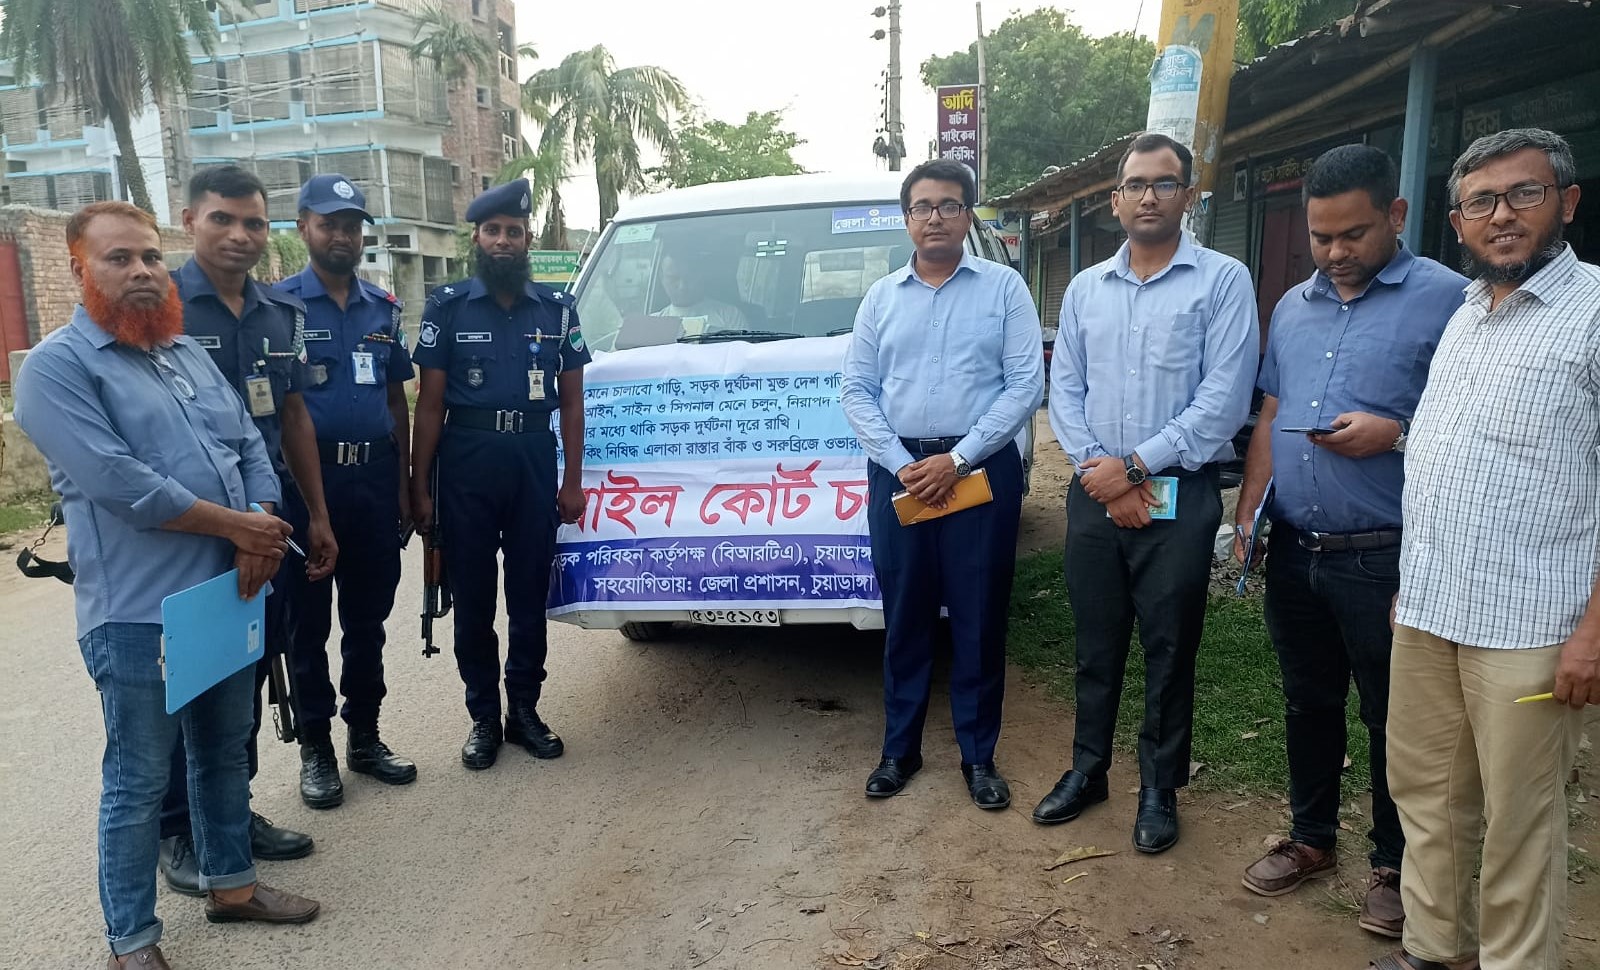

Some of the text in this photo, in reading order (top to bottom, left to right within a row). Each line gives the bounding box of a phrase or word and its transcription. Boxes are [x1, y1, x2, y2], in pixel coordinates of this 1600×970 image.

[941, 128, 976, 143] সাইকেল
[834, 215, 905, 230] জেলা প্রশাস
[584, 388, 609, 400] মেনে
[612, 384, 652, 397] চালাবো
[656, 378, 685, 396] গাড়ি,
[689, 380, 720, 394] সড়ক
[724, 374, 764, 394] দুর্ঘটনা
[766, 378, 790, 391] মুক্ত
[794, 376, 819, 389] দেশ
[585, 404, 617, 419] আইন,
[621, 402, 652, 416] সাইন
[657, 404, 666, 412] ও
[671, 399, 714, 413] সিগনাল
[719, 400, 747, 412] মেনে
[751, 398, 782, 412] চলুন,
[787, 395, 832, 408] নিরাপদ
[600, 425, 627, 438] মধ্যে
[630, 420, 656, 436] থাকি
[660, 421, 690, 436] সড়ক
[694, 416, 732, 435] দুর্ঘটনা
[736, 419, 760, 435] দূরে
[764, 414, 790, 430] রাখি
[605, 442, 640, 459] নিষিদ্ধ
[643, 442, 682, 457] এলাকা
[684, 441, 720, 455] রাস্তার
[722, 437, 748, 453] বাঁক
[752, 440, 762, 451] ও
[824, 436, 863, 450] ওভার
[577, 460, 869, 536] াইল কোর্ট চ
[586, 545, 644, 566] পরিবহন
[648, 541, 706, 571] কর্তৃপক্ষ
[712, 540, 808, 568] (বিআরটিএ),
[814, 544, 871, 566] চুয়াডাঙ্গ
[593, 572, 874, 596] সহযোগিতায়: জেলা প্রশাসন, চুয়াডাঙ্গা
